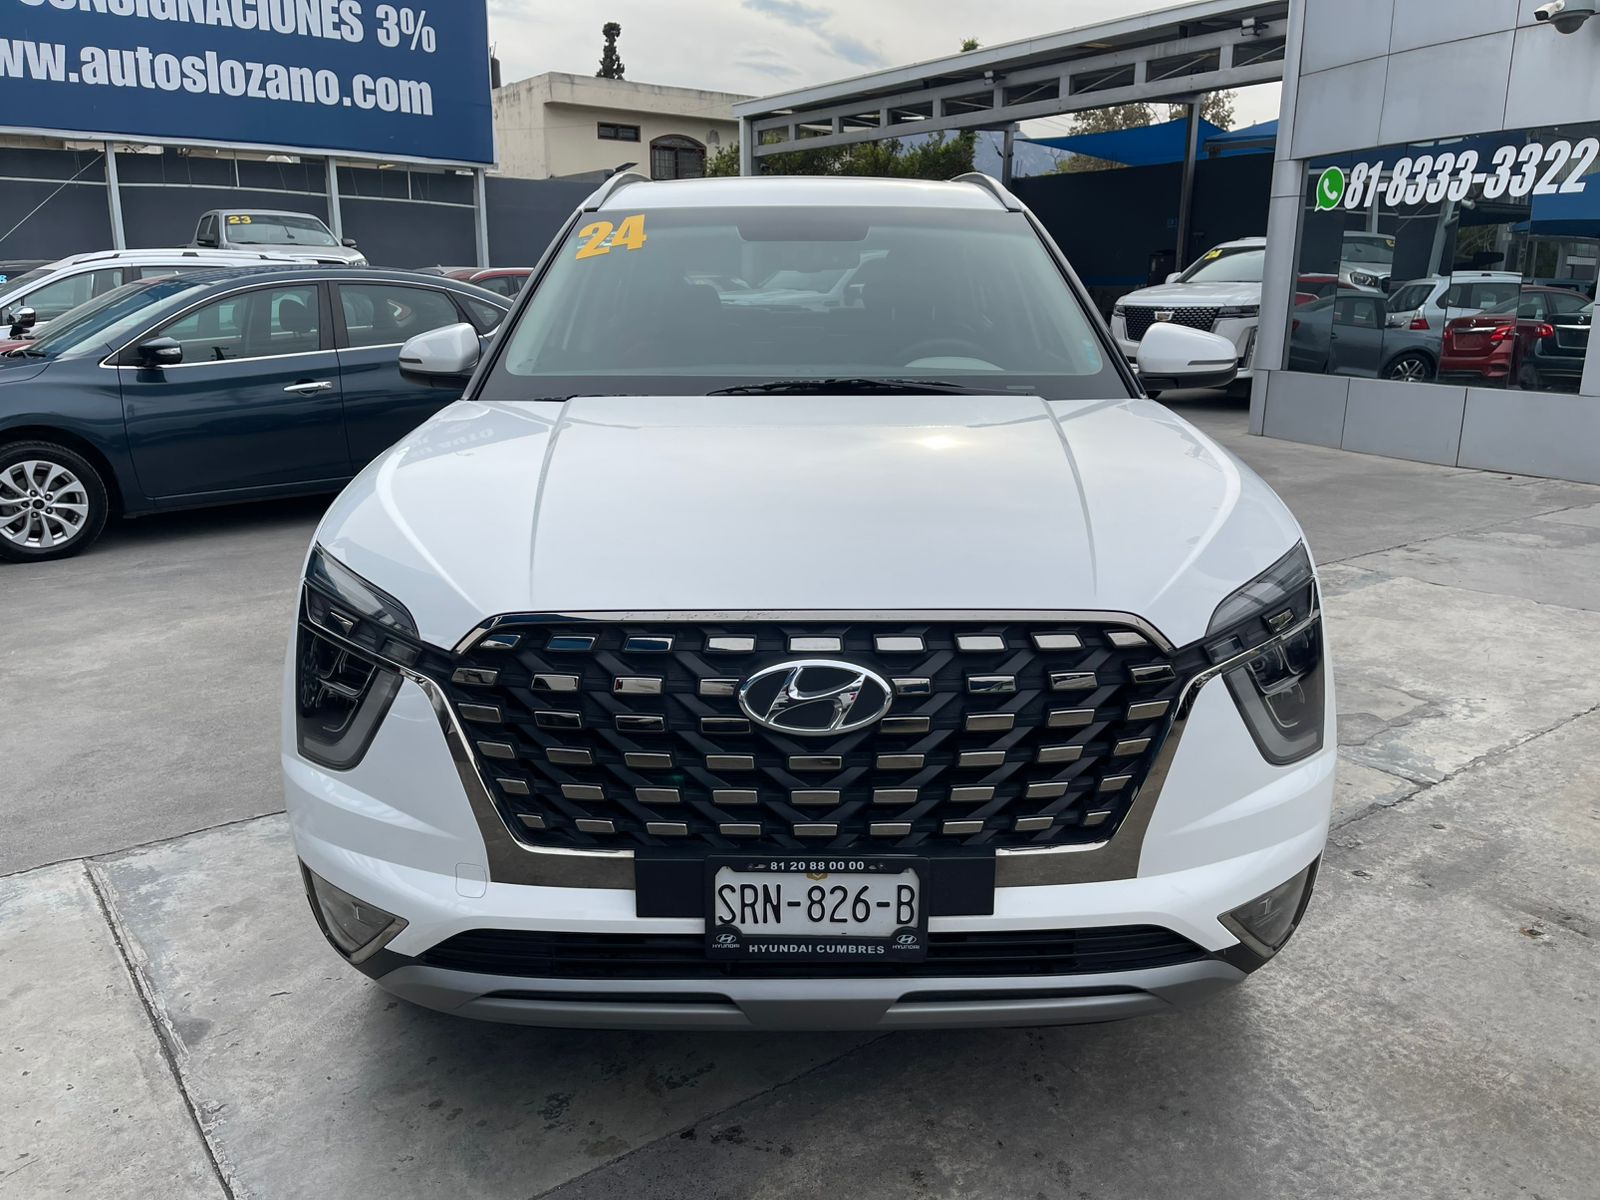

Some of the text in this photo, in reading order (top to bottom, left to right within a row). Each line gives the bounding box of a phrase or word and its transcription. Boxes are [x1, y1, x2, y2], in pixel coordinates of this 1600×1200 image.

[18, 0, 436, 53] NACIONES 3%
[1344, 137, 1600, 209] 81-8333-3322
[228, 215, 252, 225] 23
[575, 214, 647, 260] 24
[770, 861, 865, 871] 81 20 88 00 00
[717, 883, 916, 925] SRN-826-B
[748, 944, 885, 954] HYUNDAI CUMBRES
